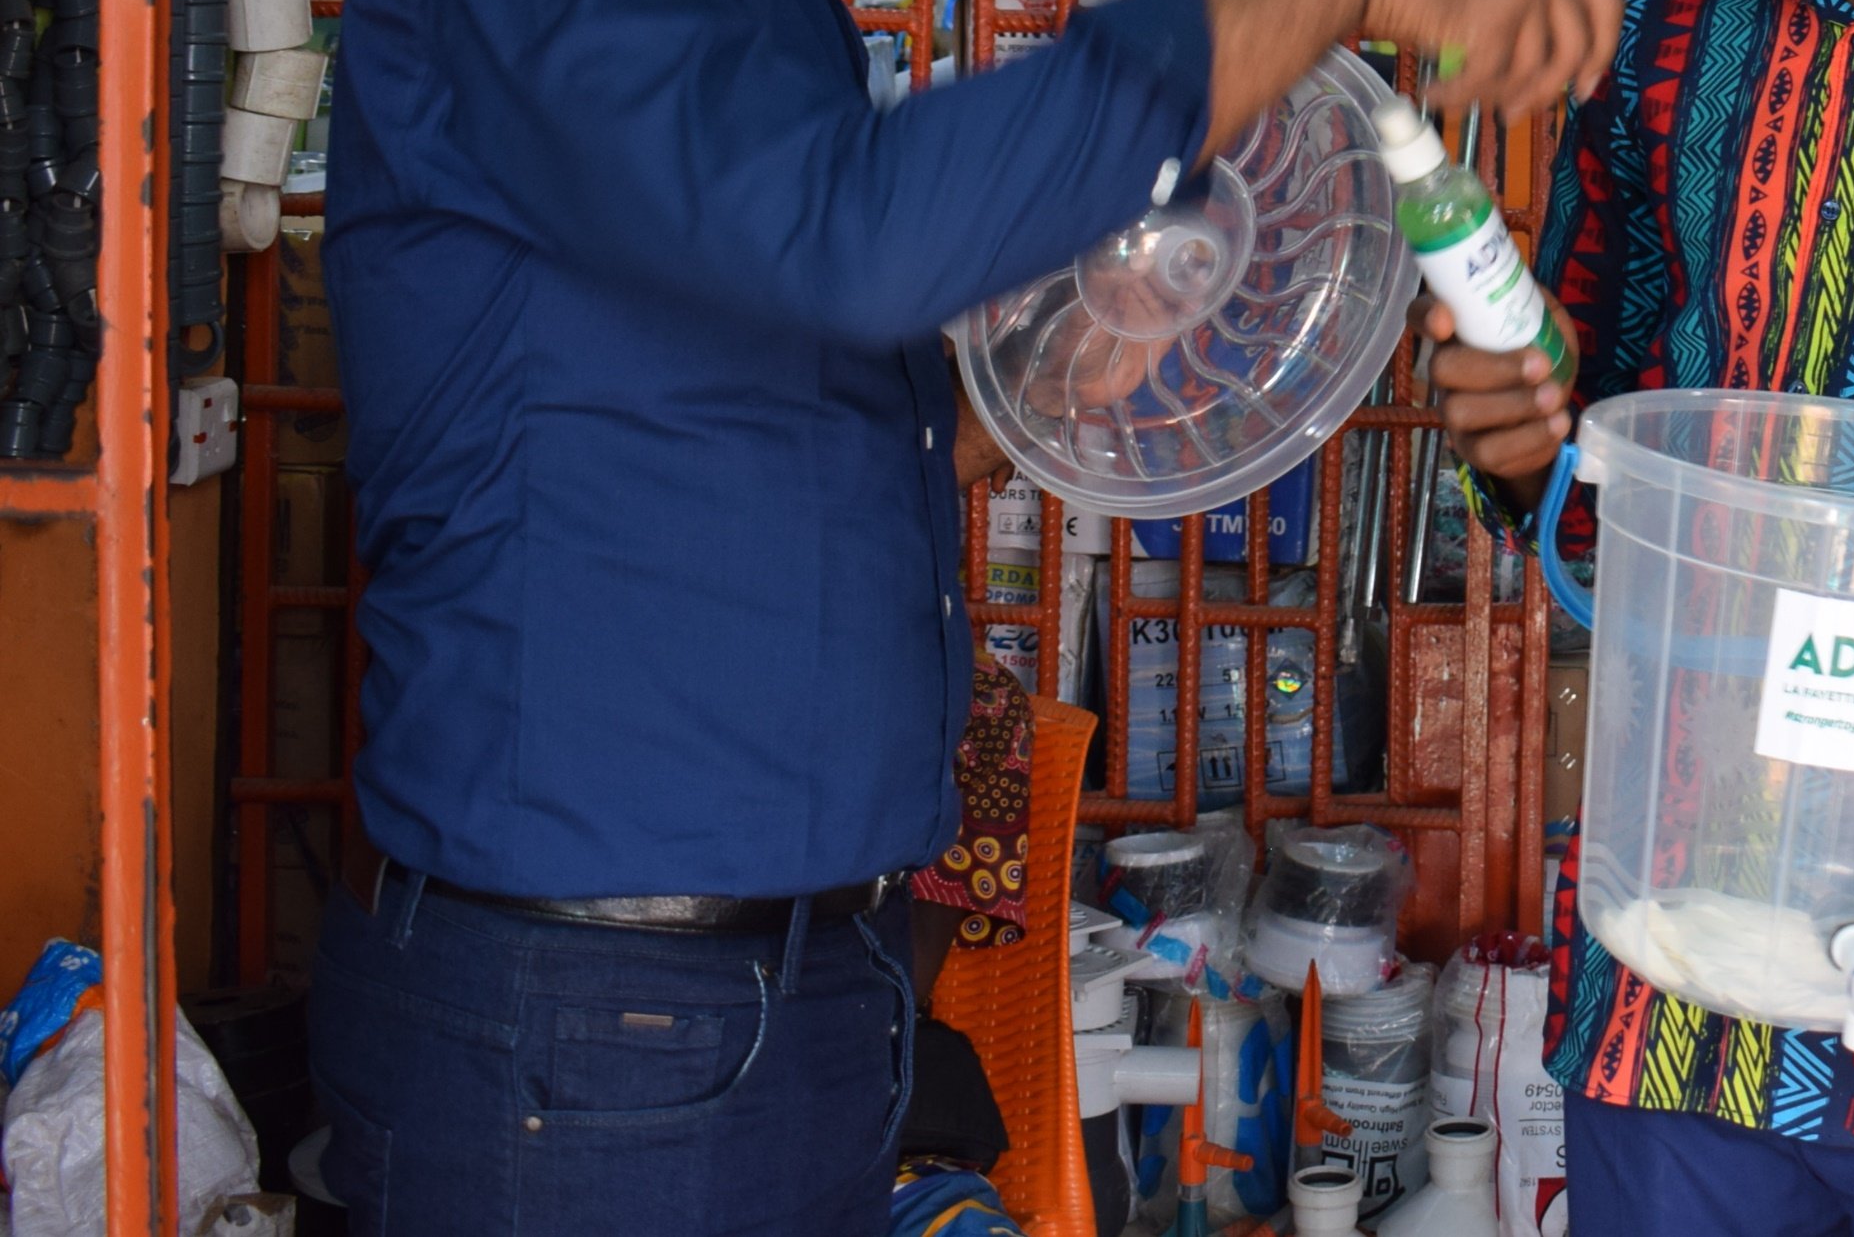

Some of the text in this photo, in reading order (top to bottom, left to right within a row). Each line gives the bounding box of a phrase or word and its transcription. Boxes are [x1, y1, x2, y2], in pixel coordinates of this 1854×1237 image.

[988, 488, 1026, 501] OURS
[991, 567, 1035, 586] RDA
[1783, 683, 1801, 696] LA
[1344, 1086, 1366, 1096] from
[1366, 1089, 1404, 1100] different
[1346, 1100, 1378, 1114] Quality
[1529, 1100, 1562, 1113] ector
[1521, 1125, 1562, 1137] SYSTEM
